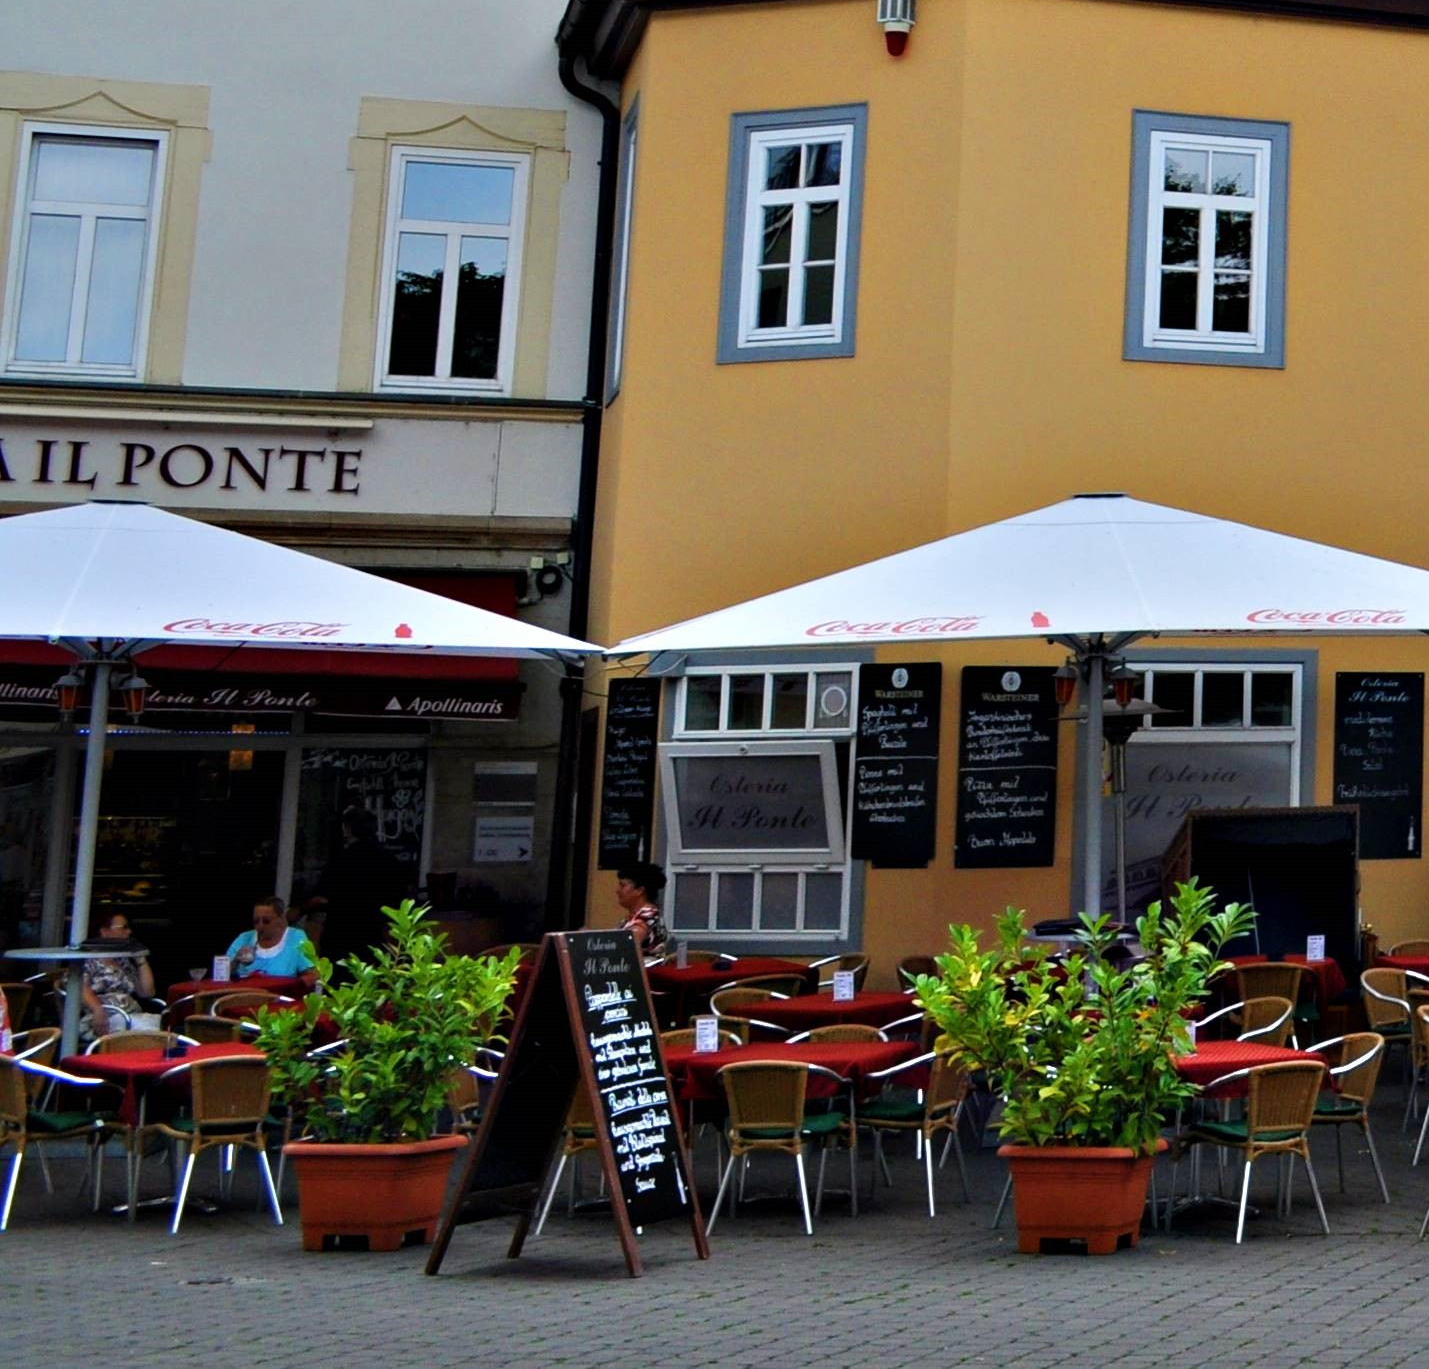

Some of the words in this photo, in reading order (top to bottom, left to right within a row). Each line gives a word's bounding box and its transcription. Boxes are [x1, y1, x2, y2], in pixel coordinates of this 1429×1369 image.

[32, 439, 99, 491] IL
[115, 442, 363, 497] PONTE
[805, 615, 989, 637] Coca-Cola
[1246, 608, 1408, 627] Coca-Cola
[163, 617, 353, 639] Coca-Cola
[874, 690, 925, 699] WARSTEINER
[981, 692, 1041, 702] WARSTEINER
[1370, 691, 1410, 703] Ponte
[405, 695, 504, 716] Apollinaris
[711, 774, 791, 794] Osteria
[1147, 764, 1241, 784] Osteria
[1124, 794, 1161, 820] Il
[687, 805, 724, 831] Il
[731, 805, 818, 831] Ponte
[587, 939, 617, 951] Osteria
[599, 958, 629, 973] Ponte
